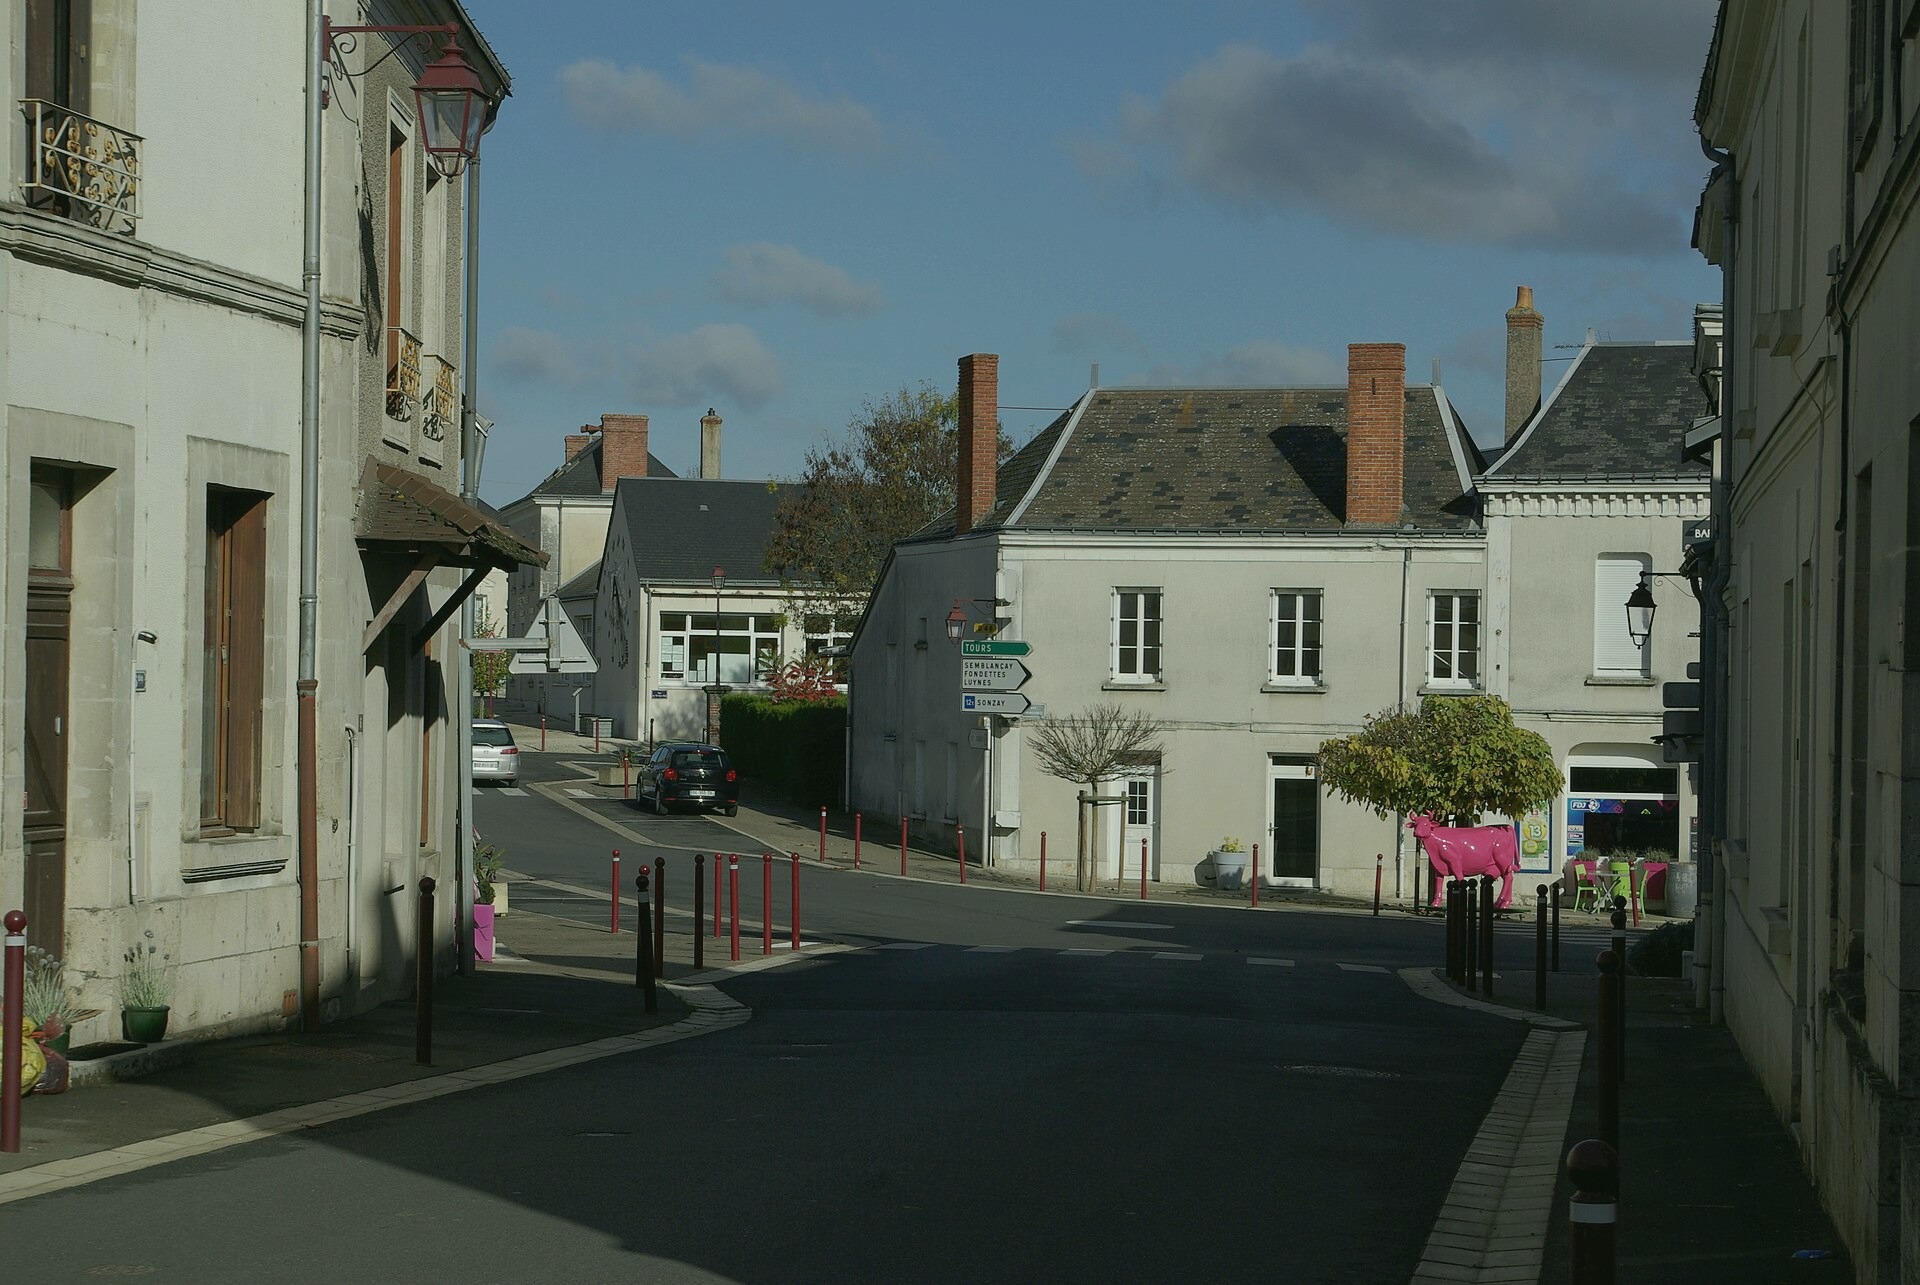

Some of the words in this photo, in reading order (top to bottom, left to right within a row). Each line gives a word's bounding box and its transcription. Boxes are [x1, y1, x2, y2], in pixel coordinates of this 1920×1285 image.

[966, 644, 991, 652] TOURS
[964, 662, 1014, 670] SEMBLANÇAY
[1529, 825, 1542, 838] 13
